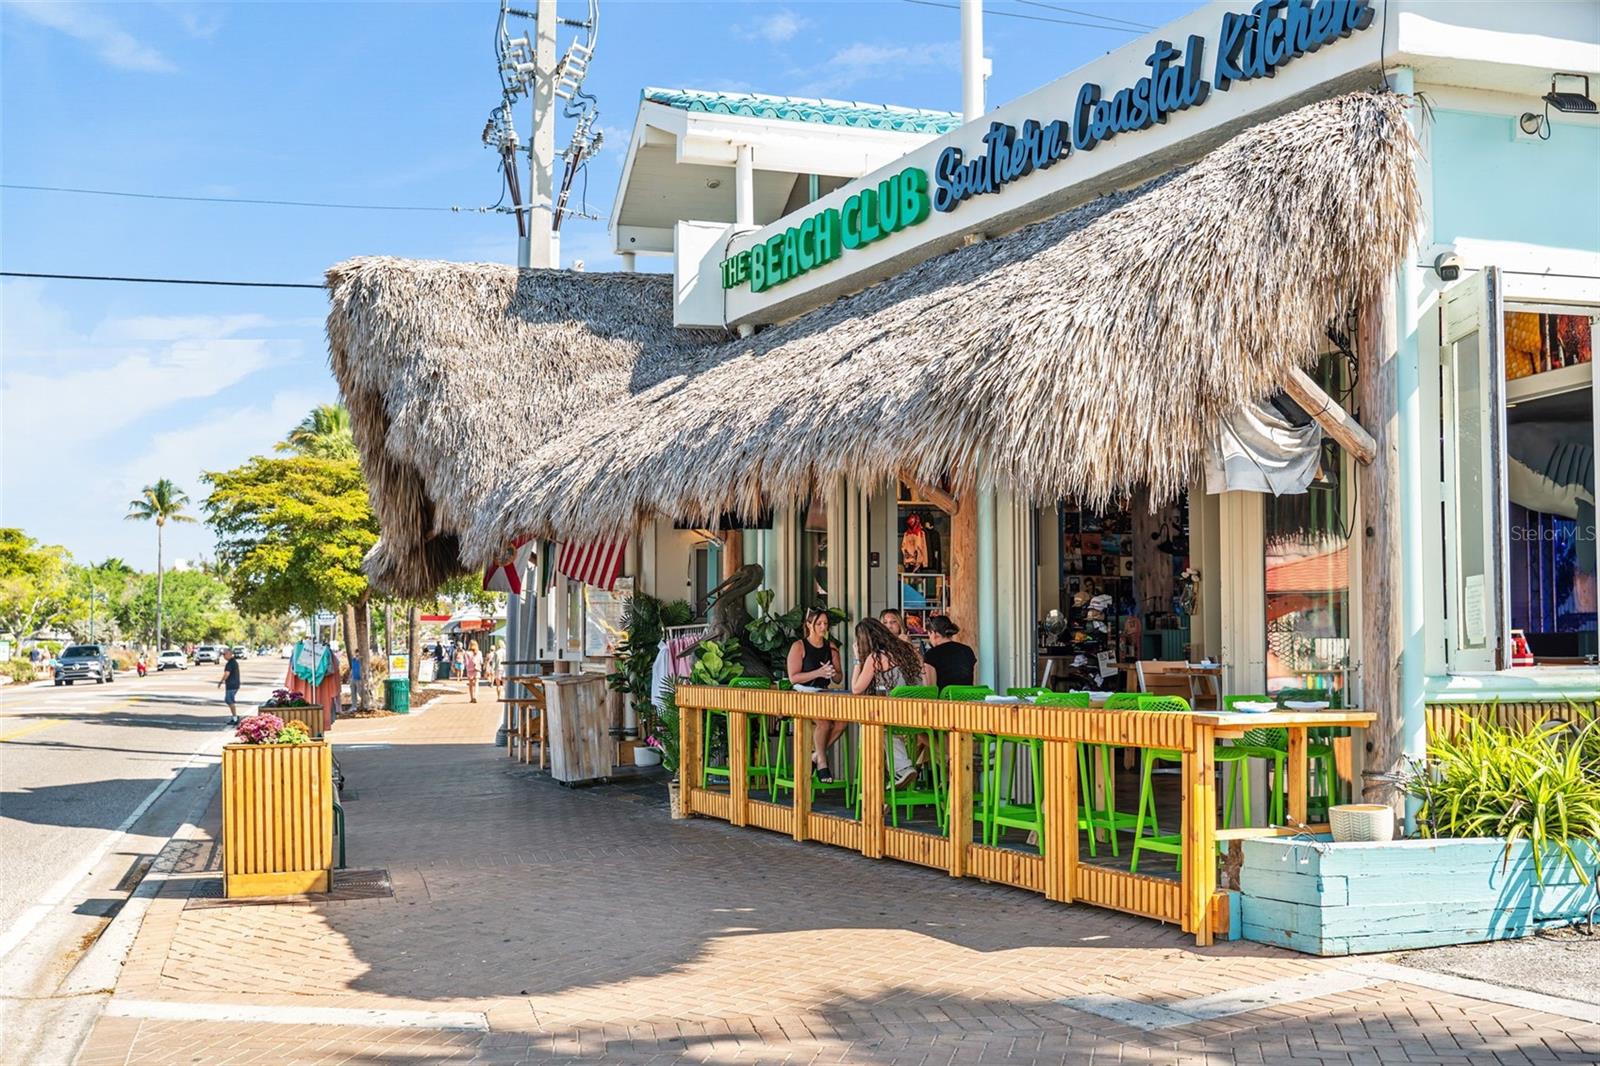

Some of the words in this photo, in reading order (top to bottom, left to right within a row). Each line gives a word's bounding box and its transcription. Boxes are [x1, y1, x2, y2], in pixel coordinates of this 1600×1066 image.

[934, 119, 1071, 213] Southern
[1073, 34, 1211, 151] Coastal
[1214, 0, 1375, 92] Kitchen
[720, 250, 750, 290] THE
[750, 207, 843, 293] BEACH
[841, 166, 931, 250] CLUB
